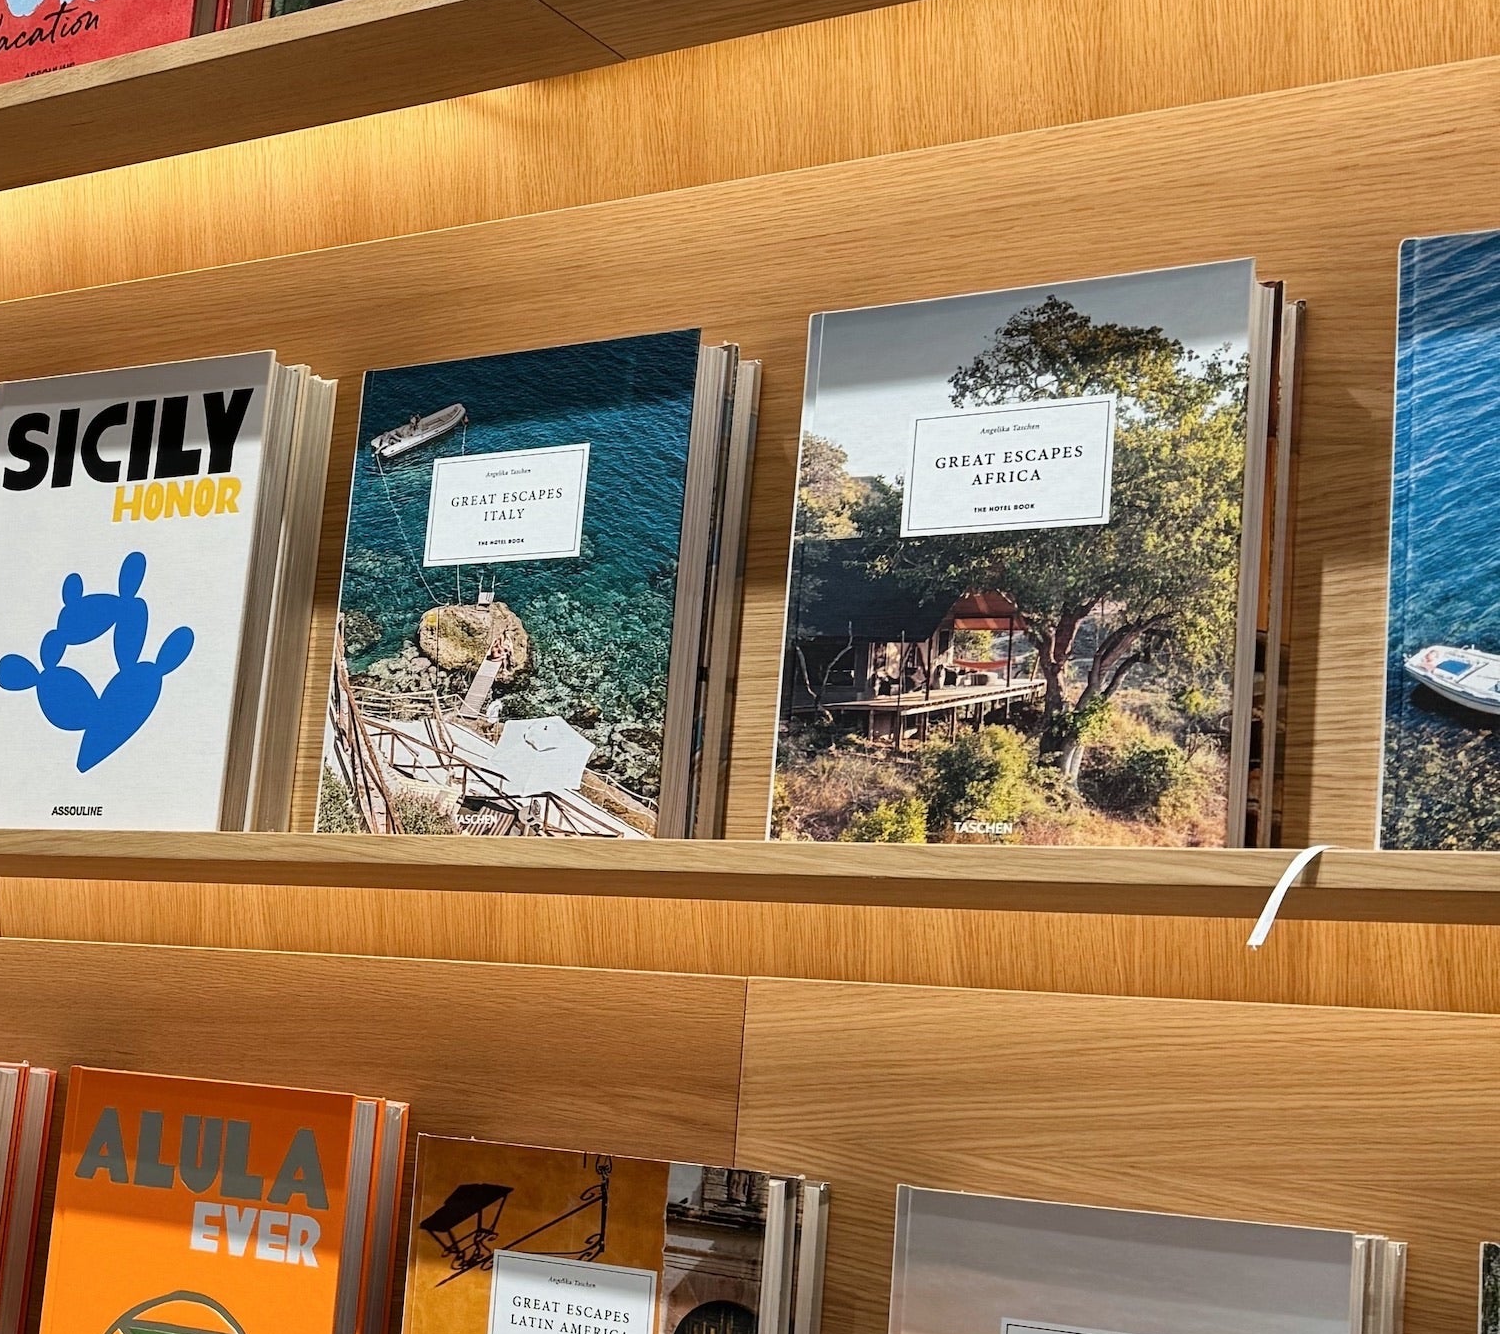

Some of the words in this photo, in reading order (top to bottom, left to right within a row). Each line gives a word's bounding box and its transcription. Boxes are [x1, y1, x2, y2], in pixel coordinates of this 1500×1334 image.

[980, 426, 1010, 435] Angelika
[1012, 423, 1040, 432] Taschen
[3, 387, 254, 491] SICILY
[935, 453, 996, 469] GREAT
[1003, 445, 1083, 464] ESCAPES
[972, 469, 1041, 486] AFRICA
[111, 477, 243, 523] HONOR
[451, 493, 497, 508] GREAT
[502, 487, 563, 503] ESCAPES
[483, 508, 525, 522] ITALY
[989, 504, 1011, 512] HOTEL
[51, 804, 103, 817] ASSOULINE
[454, 814, 498, 825] TASCHEN
[953, 821, 1013, 835] TASCHEN
[73, 1107, 330, 1211] ALULA
[189, 1201, 322, 1267] EVER
[512, 1295, 560, 1313] GREAT
[566, 1304, 630, 1323] ESCAPES
[510, 1314, 554, 1330] LATIN
